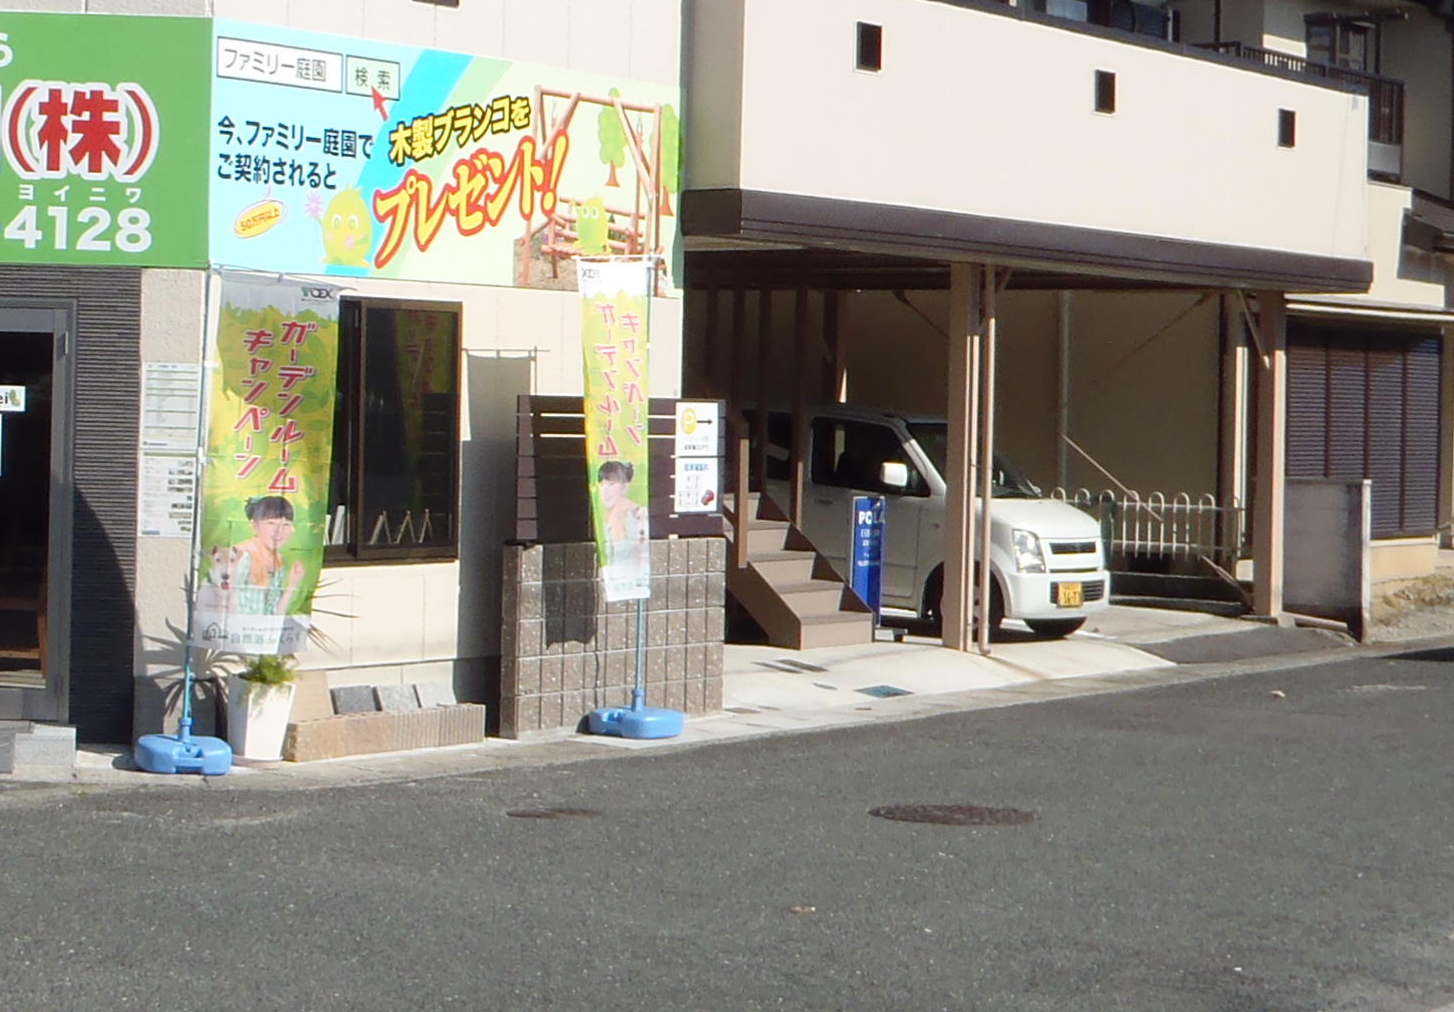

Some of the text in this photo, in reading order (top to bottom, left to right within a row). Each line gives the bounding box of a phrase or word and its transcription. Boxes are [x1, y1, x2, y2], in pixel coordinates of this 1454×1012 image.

[222, 46, 328, 84] ファミリー庭園
[353, 64, 392, 92] 検索
[217, 115, 375, 160] 今、ファミリー庭園で
[389, 94, 532, 167] 木製ブランコを
[18, 183, 145, 203] ヨイニワ
[216, 151, 338, 191] ご契約されると
[373, 129, 570, 269] プレゼント!
[233, 329, 274, 479] キャンペーン
[268, 320, 318, 493] ガーデンルーム
